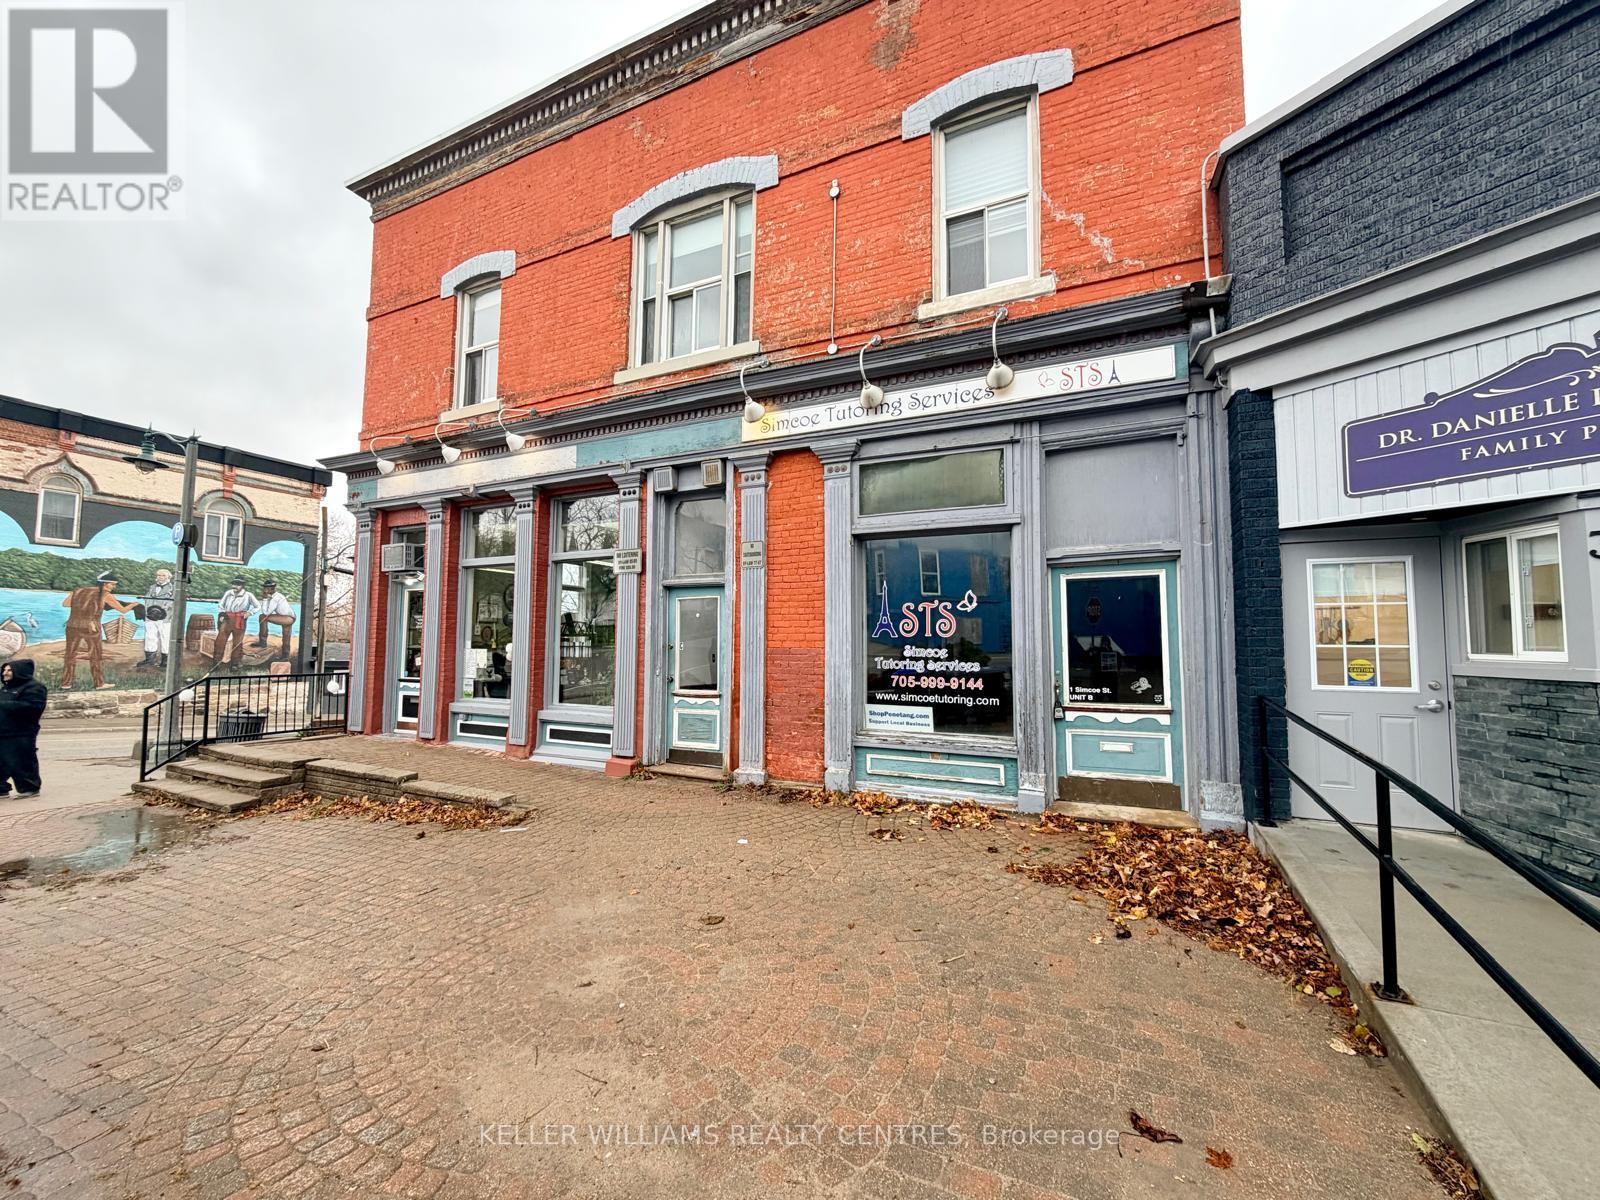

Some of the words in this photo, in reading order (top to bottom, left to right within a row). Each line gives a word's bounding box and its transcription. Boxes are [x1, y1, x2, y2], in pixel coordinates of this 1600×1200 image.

[1060, 362, 1102, 391] STS
[760, 413, 821, 434] Simcoe
[908, 386, 994, 411] Services
[1378, 429, 1422, 449] DR.
[1431, 392, 1580, 439] DANIELLE
[1461, 429, 1567, 461] FAMILY
[899, 599, 957, 638] STS
[874, 657, 925, 673] Tutoring
[926, 660, 981, 673] Services
[903, 645, 948, 659] Simcoe
[890, 675, 984, 690] 705-999-9144
[875, 692, 1000, 707] www.simcoetutoring.com
